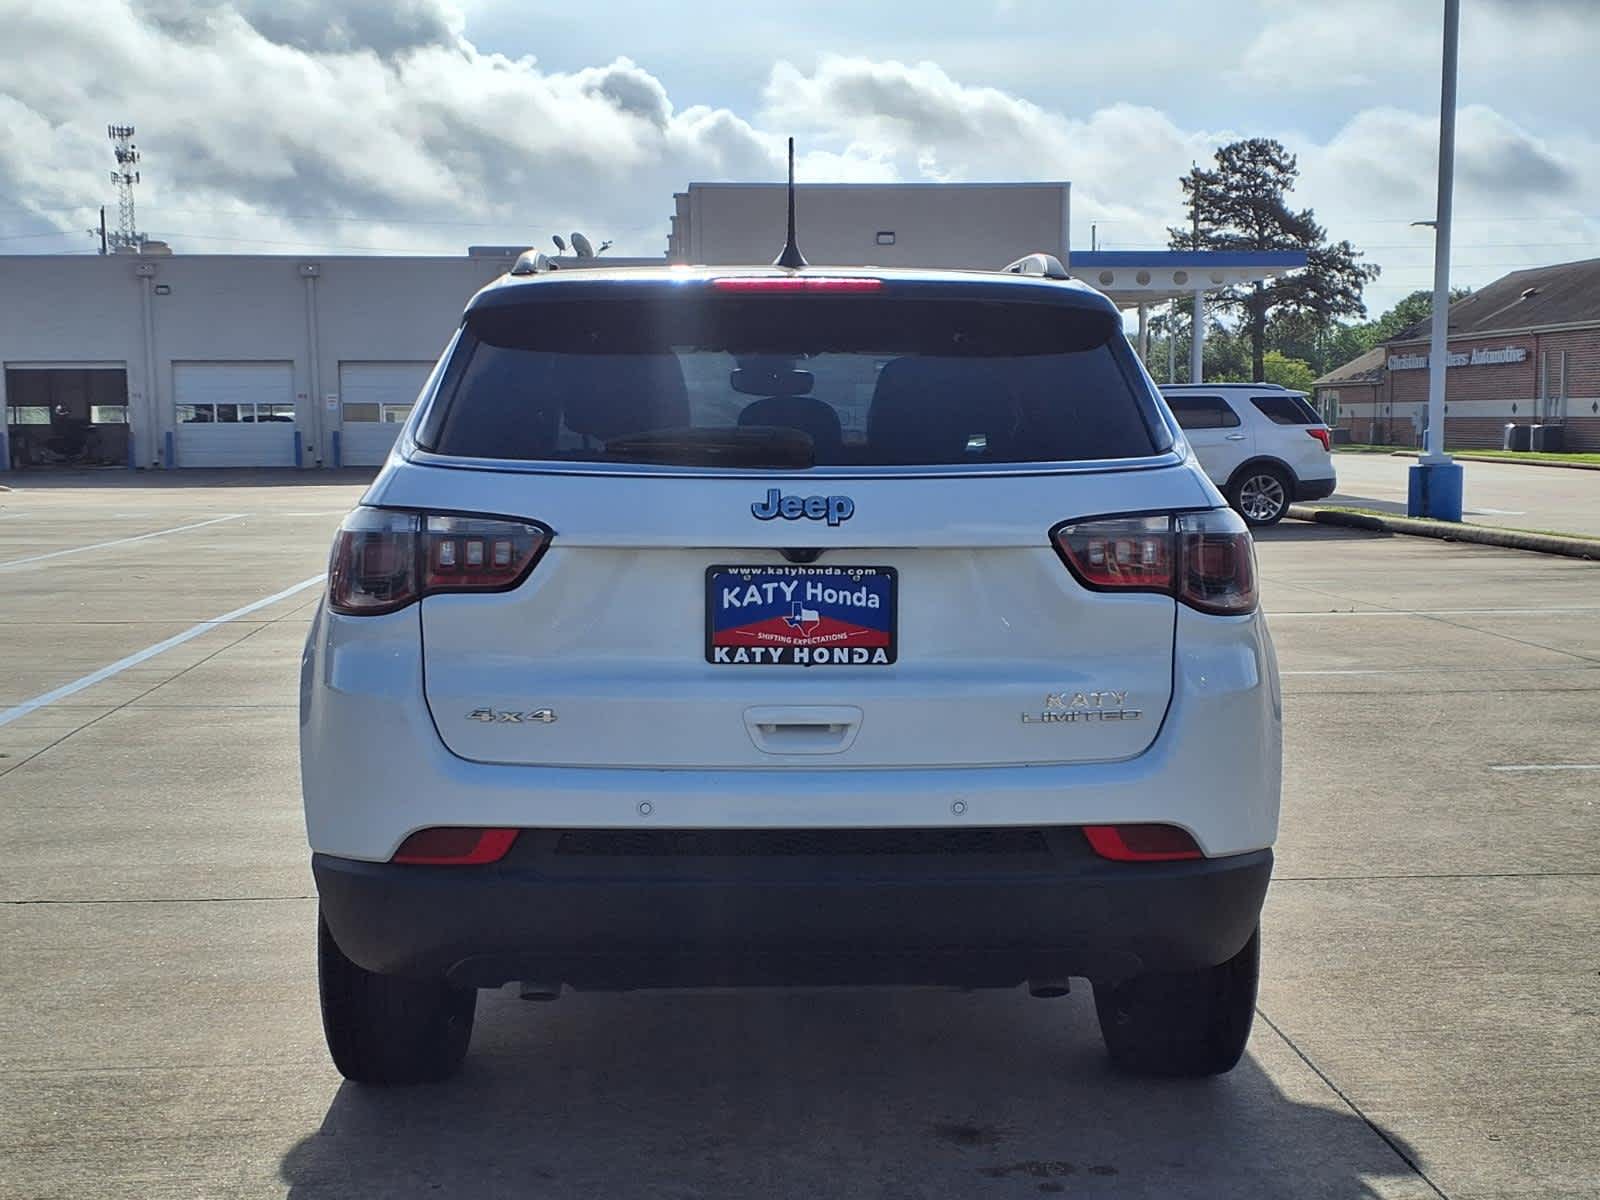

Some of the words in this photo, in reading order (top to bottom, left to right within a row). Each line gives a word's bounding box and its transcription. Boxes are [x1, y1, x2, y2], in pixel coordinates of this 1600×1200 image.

[751, 488, 855, 527] Jeep
[728, 566, 877, 577] www.katyhonda.com
[723, 580, 799, 609] KATY
[806, 581, 880, 608] Honda
[757, 632, 792, 645] SHIFTING
[793, 632, 848, 646] EXPECTATIONS
[714, 647, 785, 664] KATY
[794, 647, 889, 664] HONDA
[1046, 690, 1129, 709] KATY
[466, 707, 558, 723] 4x4
[1022, 709, 1142, 723] LIMITED
